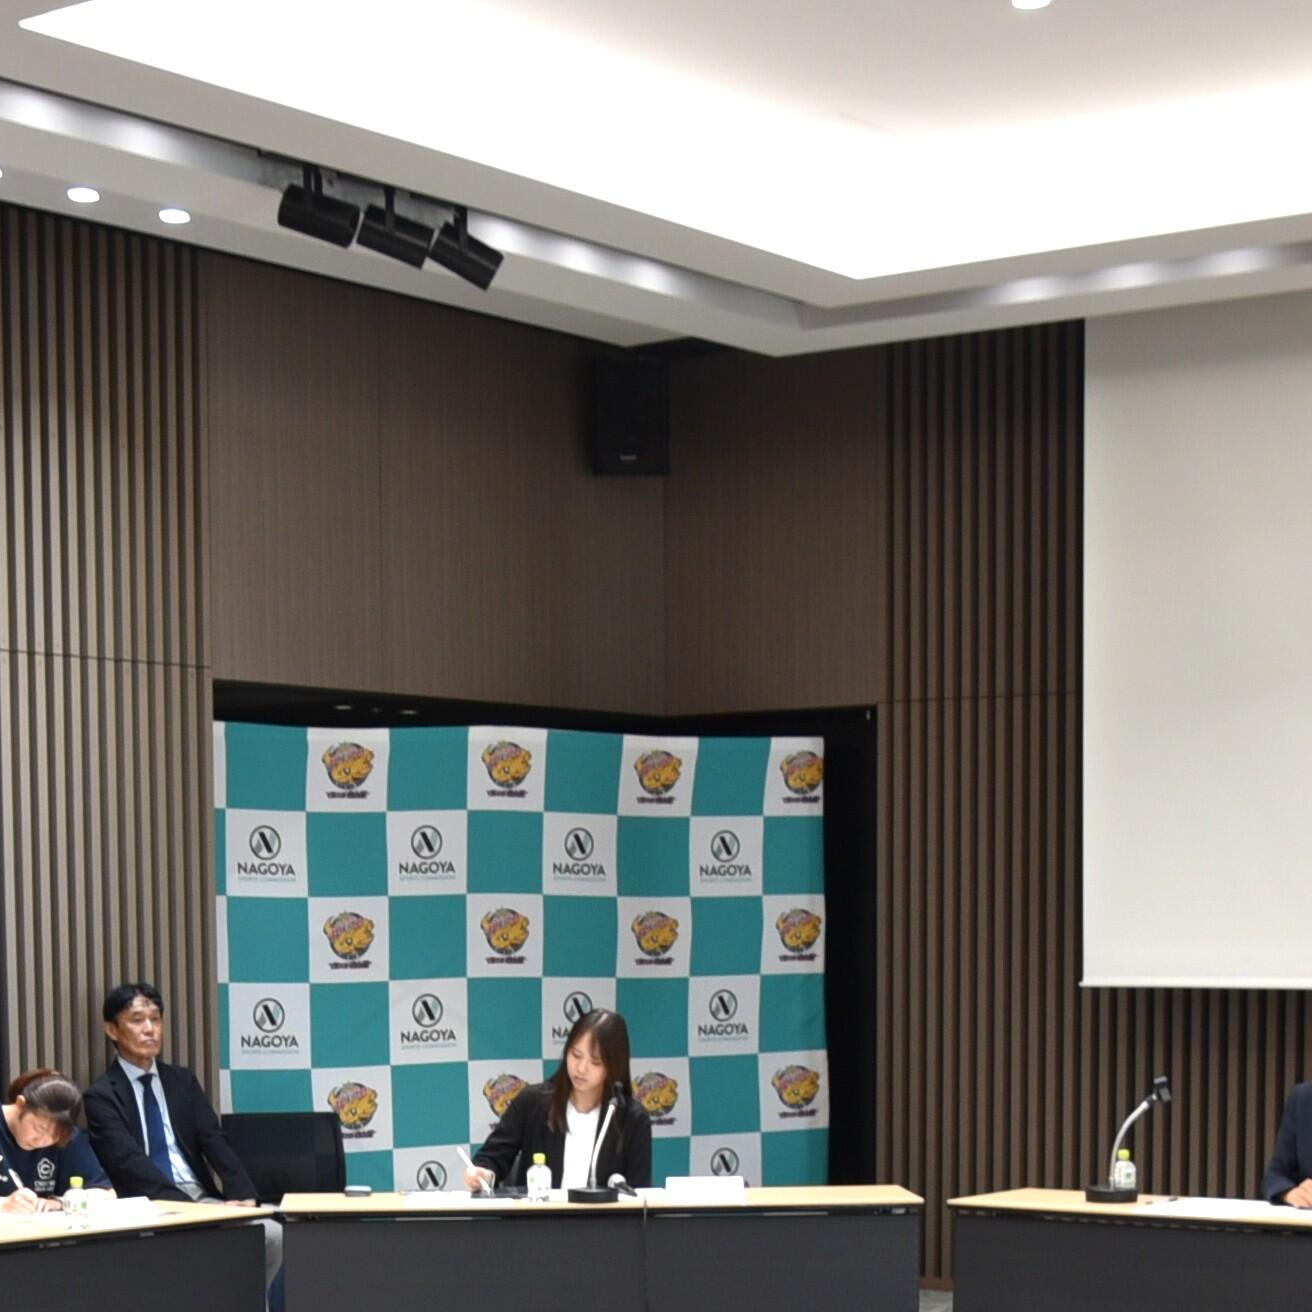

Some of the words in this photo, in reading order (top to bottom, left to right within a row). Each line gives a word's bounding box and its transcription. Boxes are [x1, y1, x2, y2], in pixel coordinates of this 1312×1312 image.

[237, 862, 296, 876] NAGOYA
[399, 861, 456, 874] NAGOYA
[552, 862, 606, 876] NAGOYA
[699, 864, 752, 876] NAGOYA
[401, 1029, 456, 1043] NAGOYA
[698, 1023, 748, 1036] NAGOYA
[241, 1035, 299, 1048] NAGOYA
